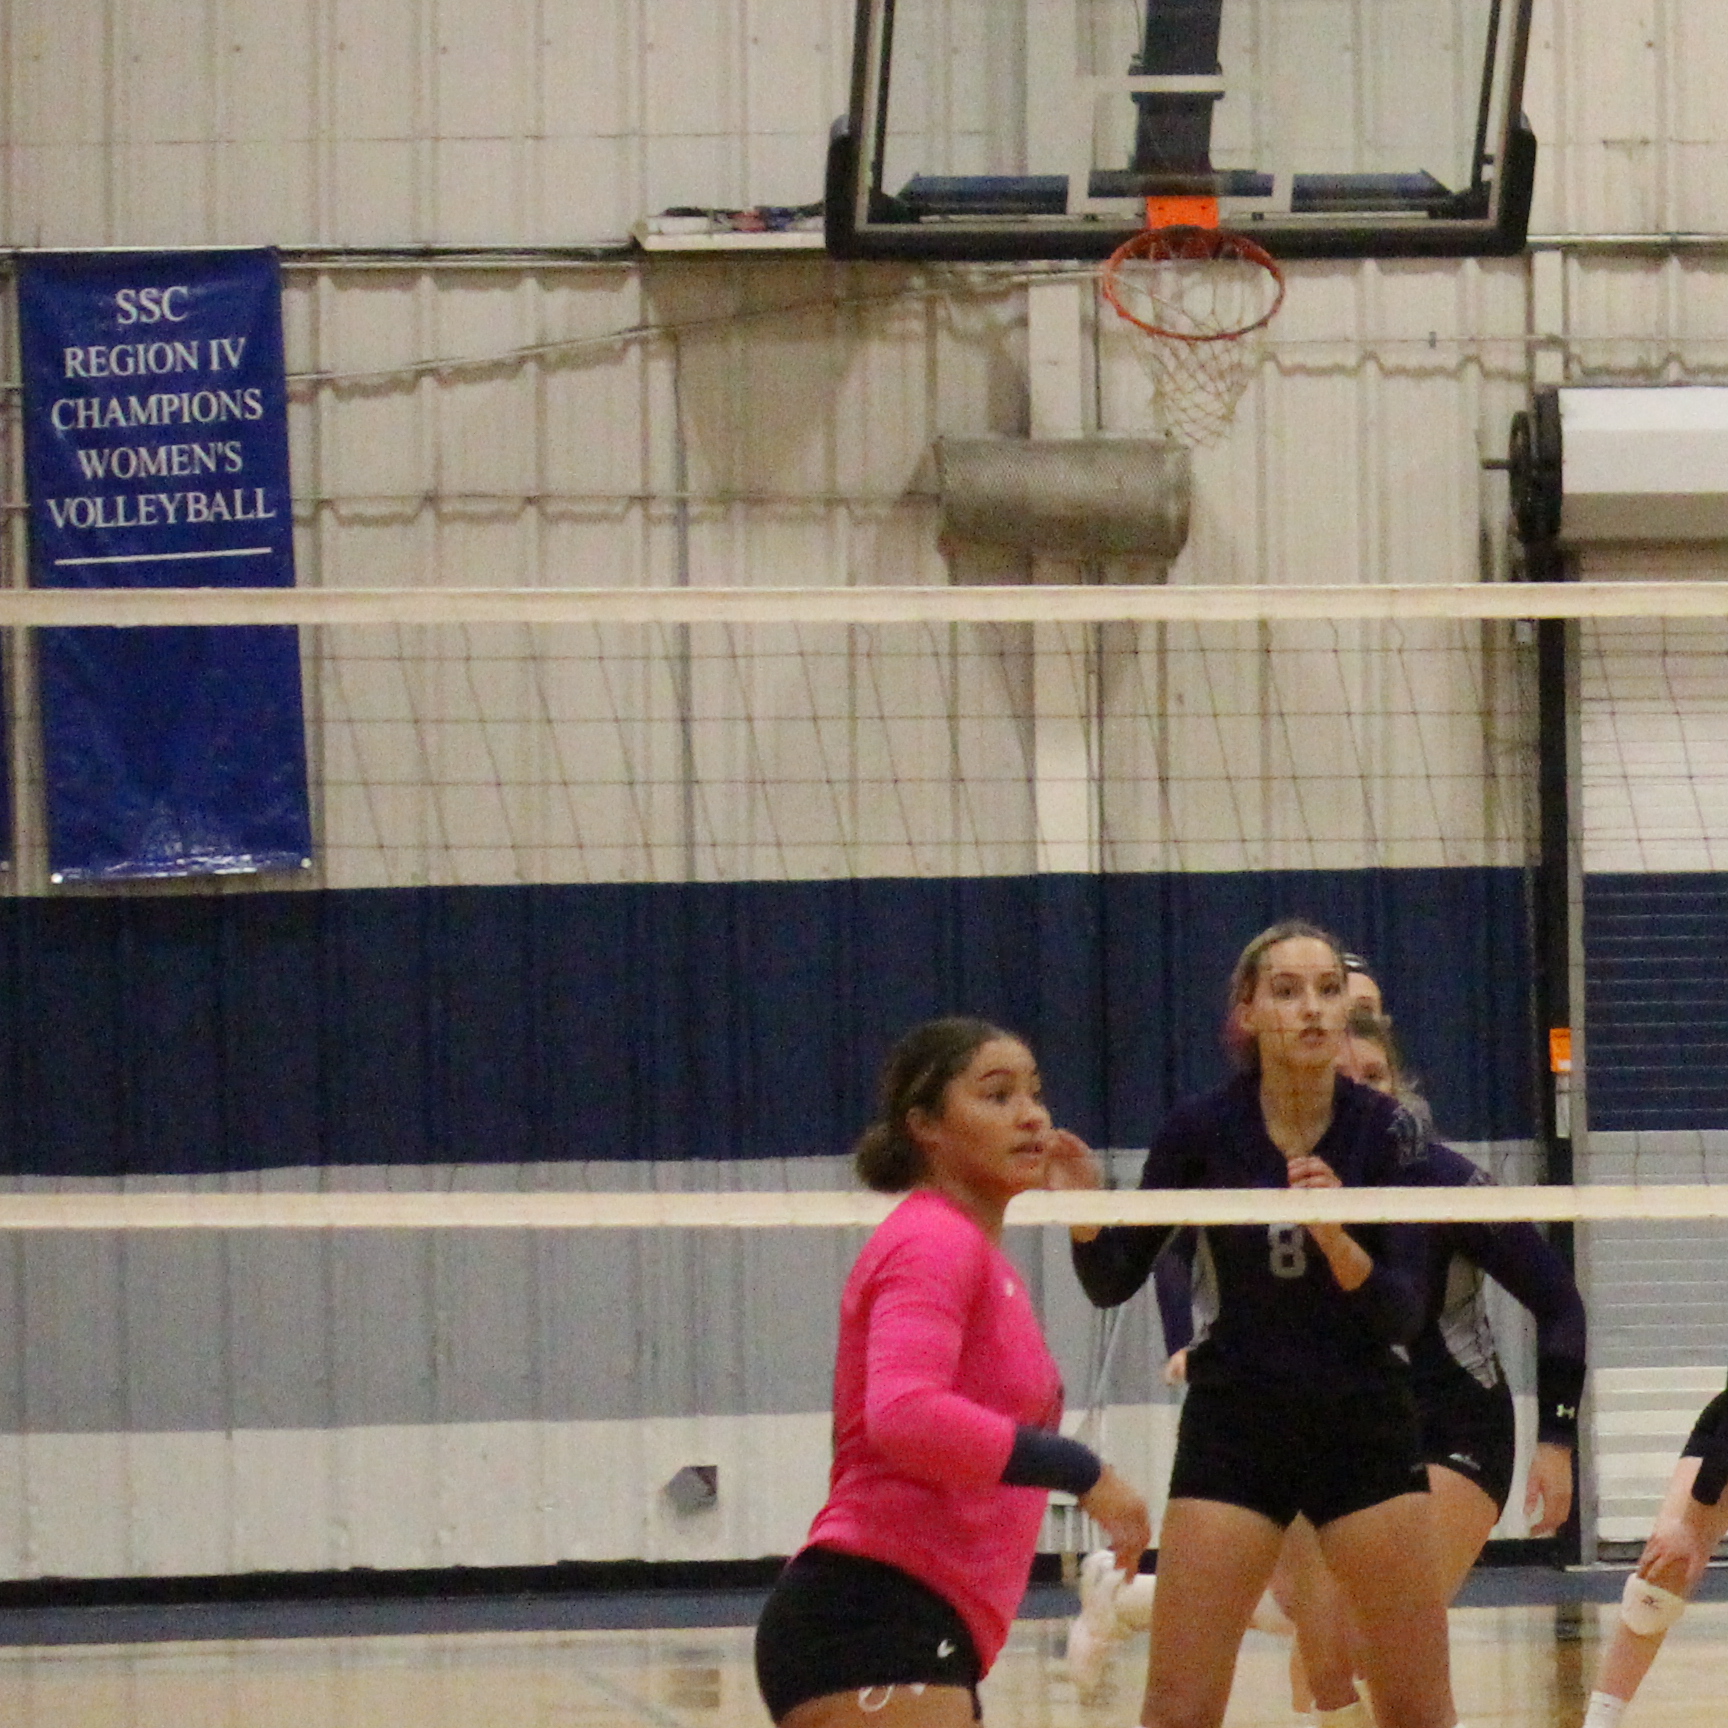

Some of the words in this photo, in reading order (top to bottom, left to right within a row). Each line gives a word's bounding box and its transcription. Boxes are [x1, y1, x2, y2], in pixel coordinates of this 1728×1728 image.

[115, 285, 189, 325] SSC
[63, 341, 199, 379] REGION
[209, 336, 247, 371] IV
[51, 388, 264, 431] CHAMPIONS
[78, 441, 243, 480] WOMEN'S
[46, 487, 277, 529] VOLLEYBALL
[1267, 1222, 1307, 1279] 8
